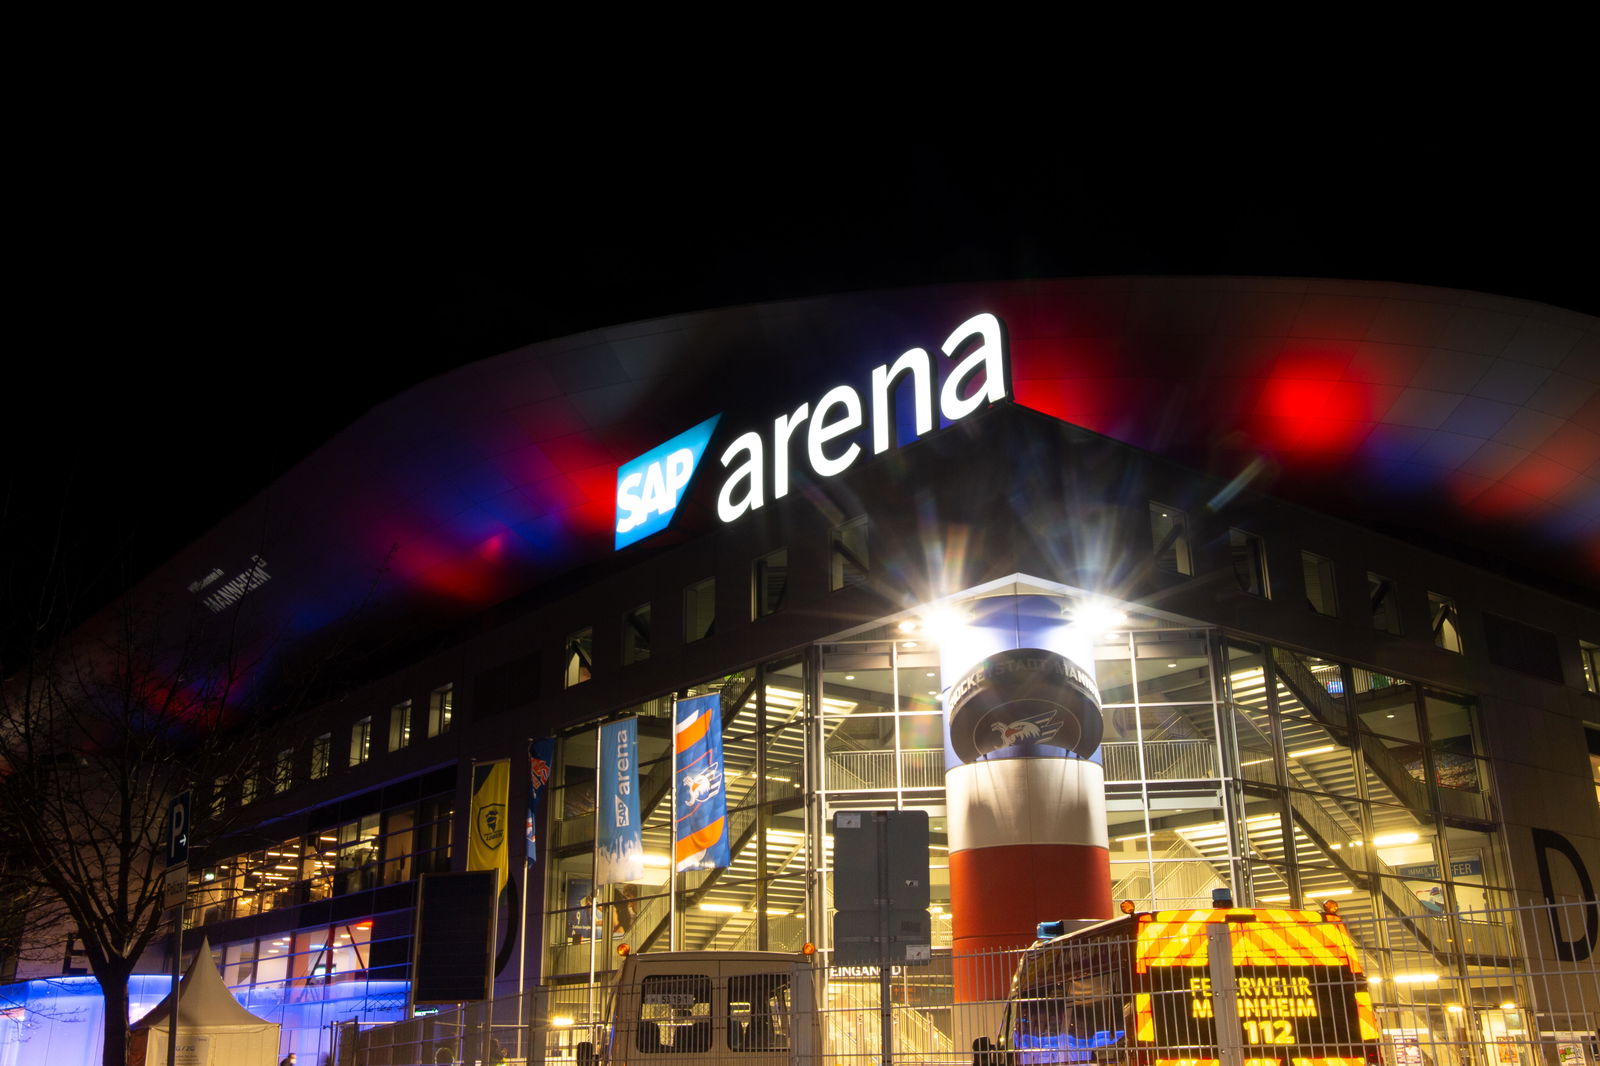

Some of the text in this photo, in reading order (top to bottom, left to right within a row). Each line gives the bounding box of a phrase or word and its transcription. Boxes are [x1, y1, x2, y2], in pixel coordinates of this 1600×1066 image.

[616, 313, 1006, 533] SAP arena
[617, 730, 630, 825] SAP arena
[171, 803, 184, 858] P
[1532, 828, 1598, 961] D
[830, 965, 901, 977] EINGAN D
[1190, 977, 1312, 997] FERWEHR
[1193, 998, 1318, 1018] MNHEIM
[1243, 1020, 1296, 1044] 112
